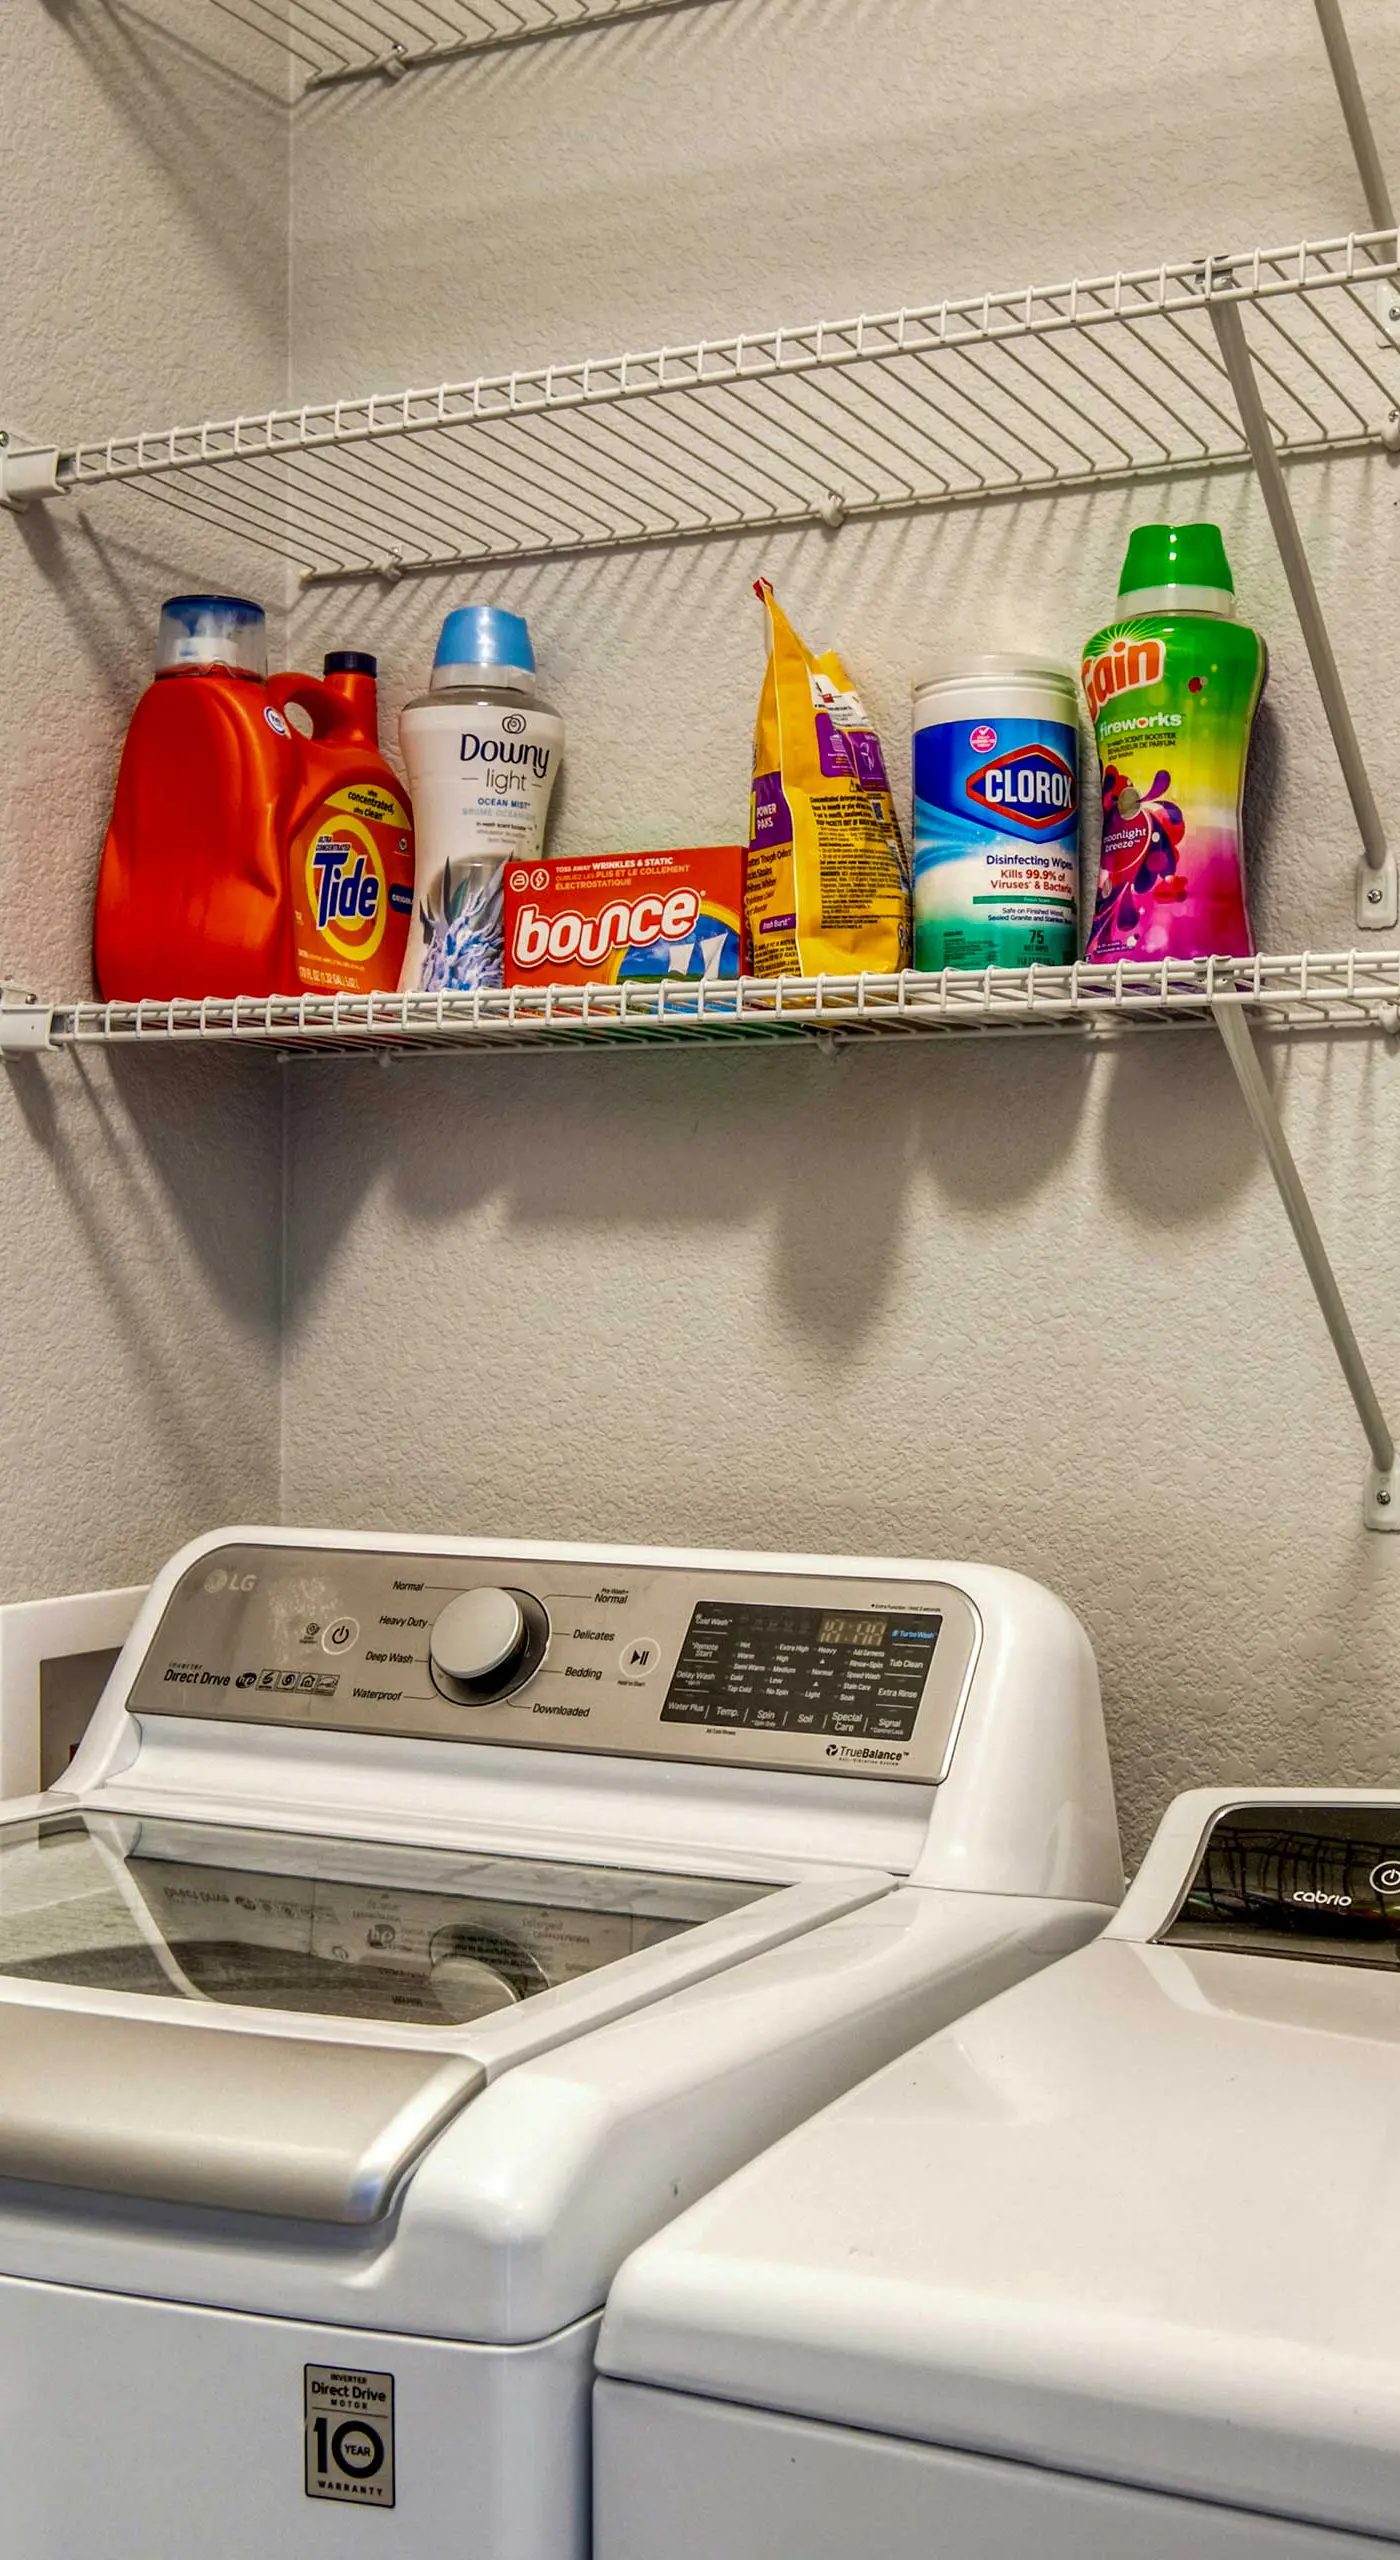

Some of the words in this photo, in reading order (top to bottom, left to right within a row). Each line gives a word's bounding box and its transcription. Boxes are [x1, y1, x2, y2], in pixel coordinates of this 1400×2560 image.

[1099, 712, 1182, 740] fireworks
[1125, 734, 1143, 743] SCENT
[1145, 732, 1176, 741] BOOSTER
[460, 733, 549, 778] Downy
[486, 768, 526, 794] light
[985, 769, 1072, 808] CLOROX
[478, 798, 508, 807] OCEAN
[757, 803, 777, 816] POWER
[757, 817, 773, 831] PAKS
[592, 860, 635, 870] WRINKLES
[637, 859, 643, 867] &
[644, 857, 673, 866] STATIC
[986, 855, 1050, 868] Disinfecting
[595, 871, 613, 879] PLIS
[639, 864, 690, 876] COLLEMENT
[1001, 869, 1023, 879] Kills
[1025, 869, 1056, 880] 99.9%
[1058, 873, 1066, 882] of
[312, 852, 379, 930] Tide
[988, 914, 1009, 922] Sealed
[512, 887, 700, 968] bounce
[1029, 930, 1044, 944] 75
[228, 1574, 257, 1592] LG
[393, 1581, 424, 1591] Normal
[594, 1592, 628, 1604] Normal
[380, 1616, 406, 1627] Heavy
[407, 1617, 428, 1629] Duty
[573, 1629, 615, 1641] Delicates
[780, 1643, 795, 1651] Extra
[818, 1647, 837, 1655] Heavy
[365, 1651, 387, 1662] Deep
[389, 1653, 413, 1664] Wash
[776, 1655, 789, 1663] High
[889, 1659, 902, 1667] Tub
[903, 1660, 923, 1668] Clean
[164, 1669, 199, 1683] Direct
[200, 1671, 230, 1686] Drive
[565, 1667, 602, 1680] Bedding
[676, 1671, 695, 1680] Delay
[696, 1672, 715, 1680] Wash
[352, 1688, 403, 1701] Waterproof
[805, 1691, 820, 1699] Light
[878, 1687, 897, 1697] Extra
[898, 1689, 918, 1698] Rinse
[532, 1703, 590, 1717] Downloaded
[668, 1702, 689, 1710] Water
[690, 1703, 704, 1712] Plus
[717, 1706, 739, 1718] Temp.
[757, 1709, 775, 1720] Spin
[798, 1713, 814, 1723] Soil
[832, 1712, 862, 1723] Special
[834, 1723, 855, 1732] Care
[878, 1718, 901, 1728] Signal
[1293, 1890, 1351, 1906] cabrio
[330, 2373, 367, 2384] INVERTER
[312, 2381, 349, 2398] Direct
[352, 2386, 386, 2402] Drive
[331, 2399, 368, 2409] MOTOR
[313, 2417, 384, 2479] 10
[344, 2443, 371, 2457] YEAR
[318, 2479, 383, 2496] WARRANTY
